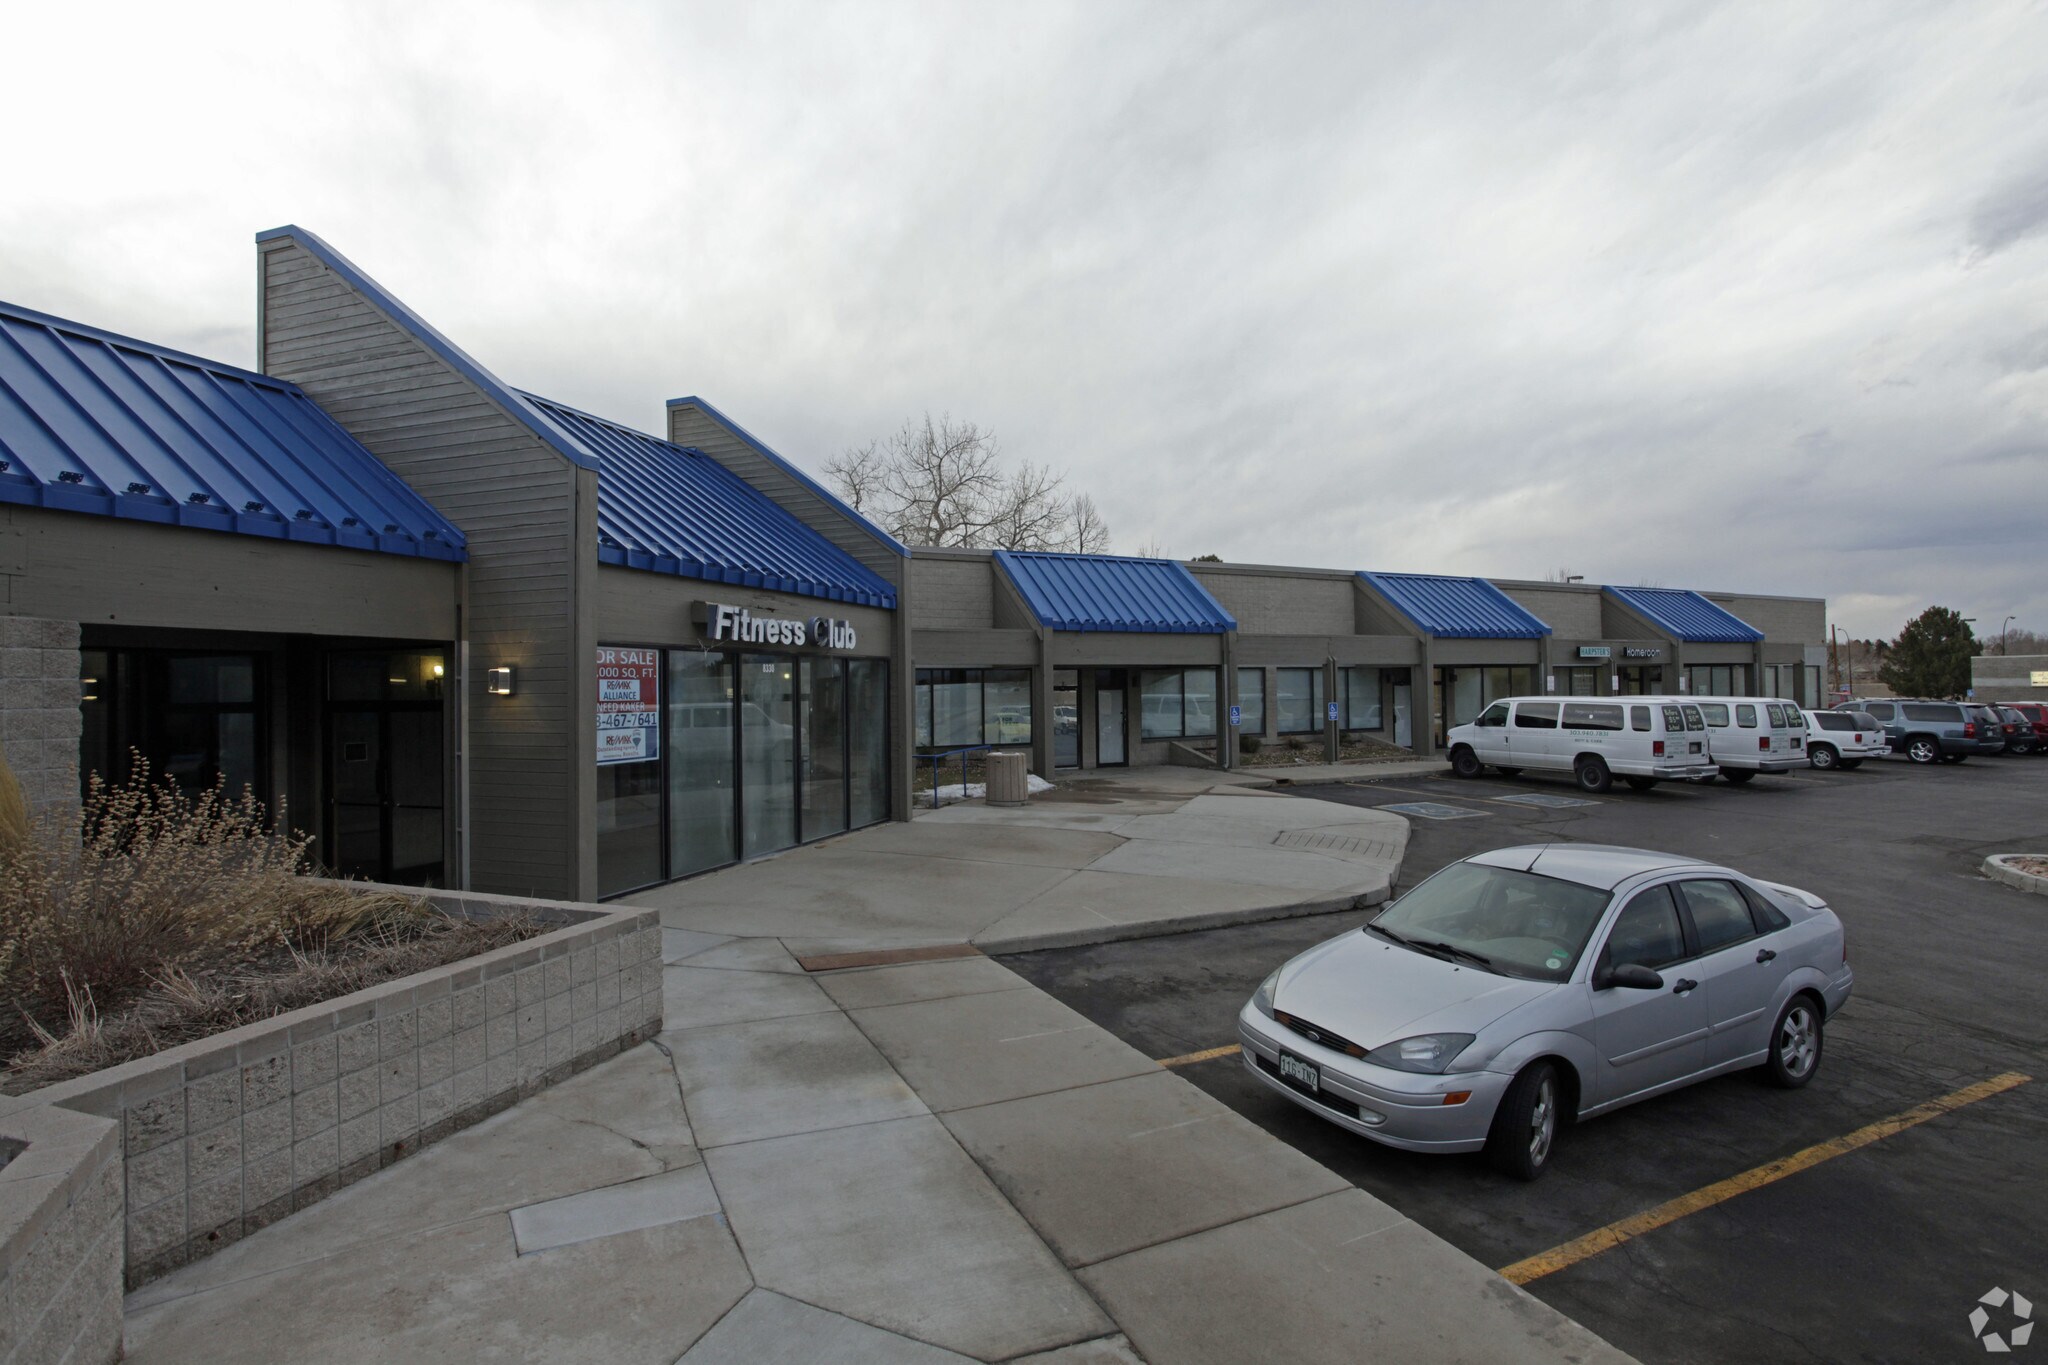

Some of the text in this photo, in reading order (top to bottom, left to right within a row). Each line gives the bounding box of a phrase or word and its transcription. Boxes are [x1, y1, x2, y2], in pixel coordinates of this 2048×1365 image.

[712, 603, 857, 650] Fitness Club
[1626, 646, 1661, 657] Homeroom
[597, 650, 653, 665] OR SALE
[622, 668, 639, 679] SQ.
[642, 668, 657, 678] FT.
[603, 691, 637, 700] ALLIANCE
[620, 703, 645, 712] KAKER
[597, 713, 657, 728] 3-467-7641
